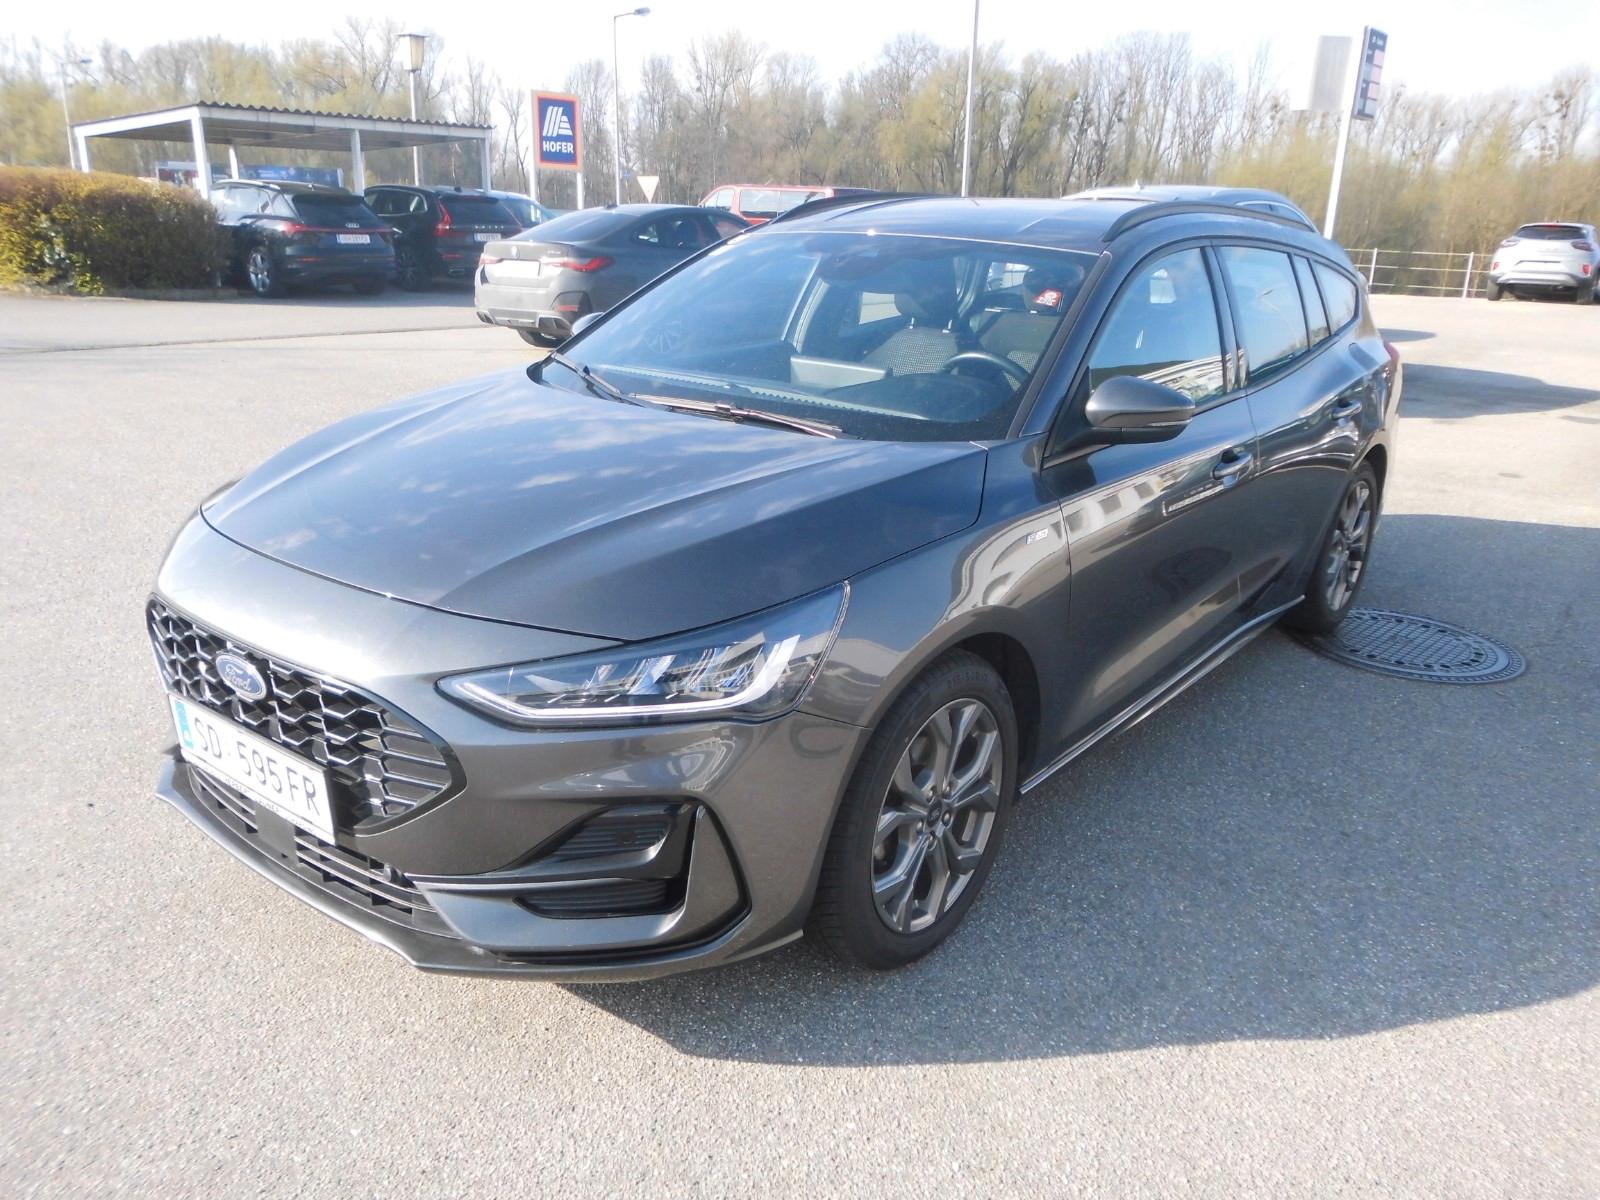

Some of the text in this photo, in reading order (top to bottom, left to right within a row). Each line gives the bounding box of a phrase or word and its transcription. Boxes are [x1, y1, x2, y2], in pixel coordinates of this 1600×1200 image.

[542, 140, 574, 154] HOFER
[225, 663, 252, 692] Ford
[193, 717, 223, 760] SD
